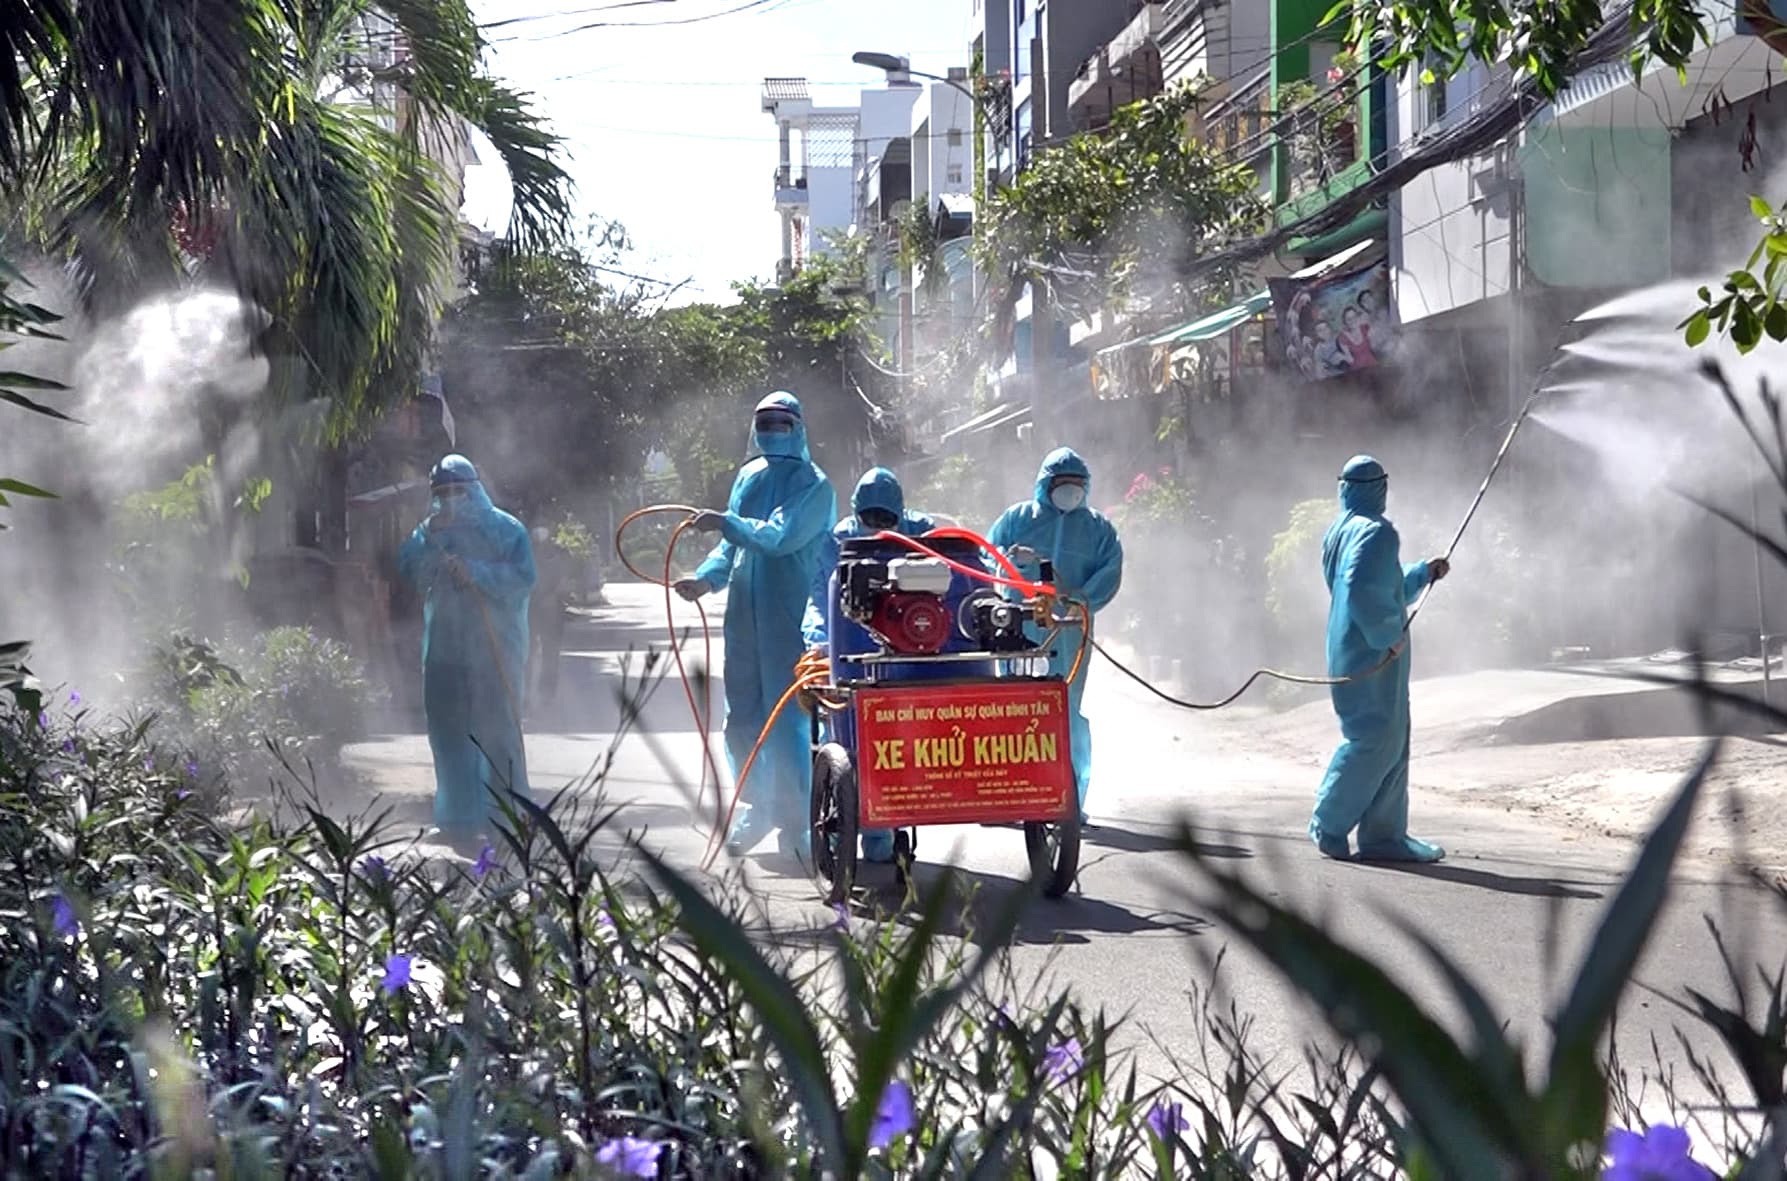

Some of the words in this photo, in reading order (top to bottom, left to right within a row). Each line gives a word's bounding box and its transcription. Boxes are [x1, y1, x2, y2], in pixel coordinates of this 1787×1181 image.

[876, 709, 896, 722] BAN
[915, 707, 935, 720] HUY
[964, 704, 977, 720] SỰ
[1030, 701, 1050, 716] TÂN
[873, 739, 905, 770] XE
[914, 725, 967, 769] KHỬ
[973, 718, 1057, 766] KHUẨN
